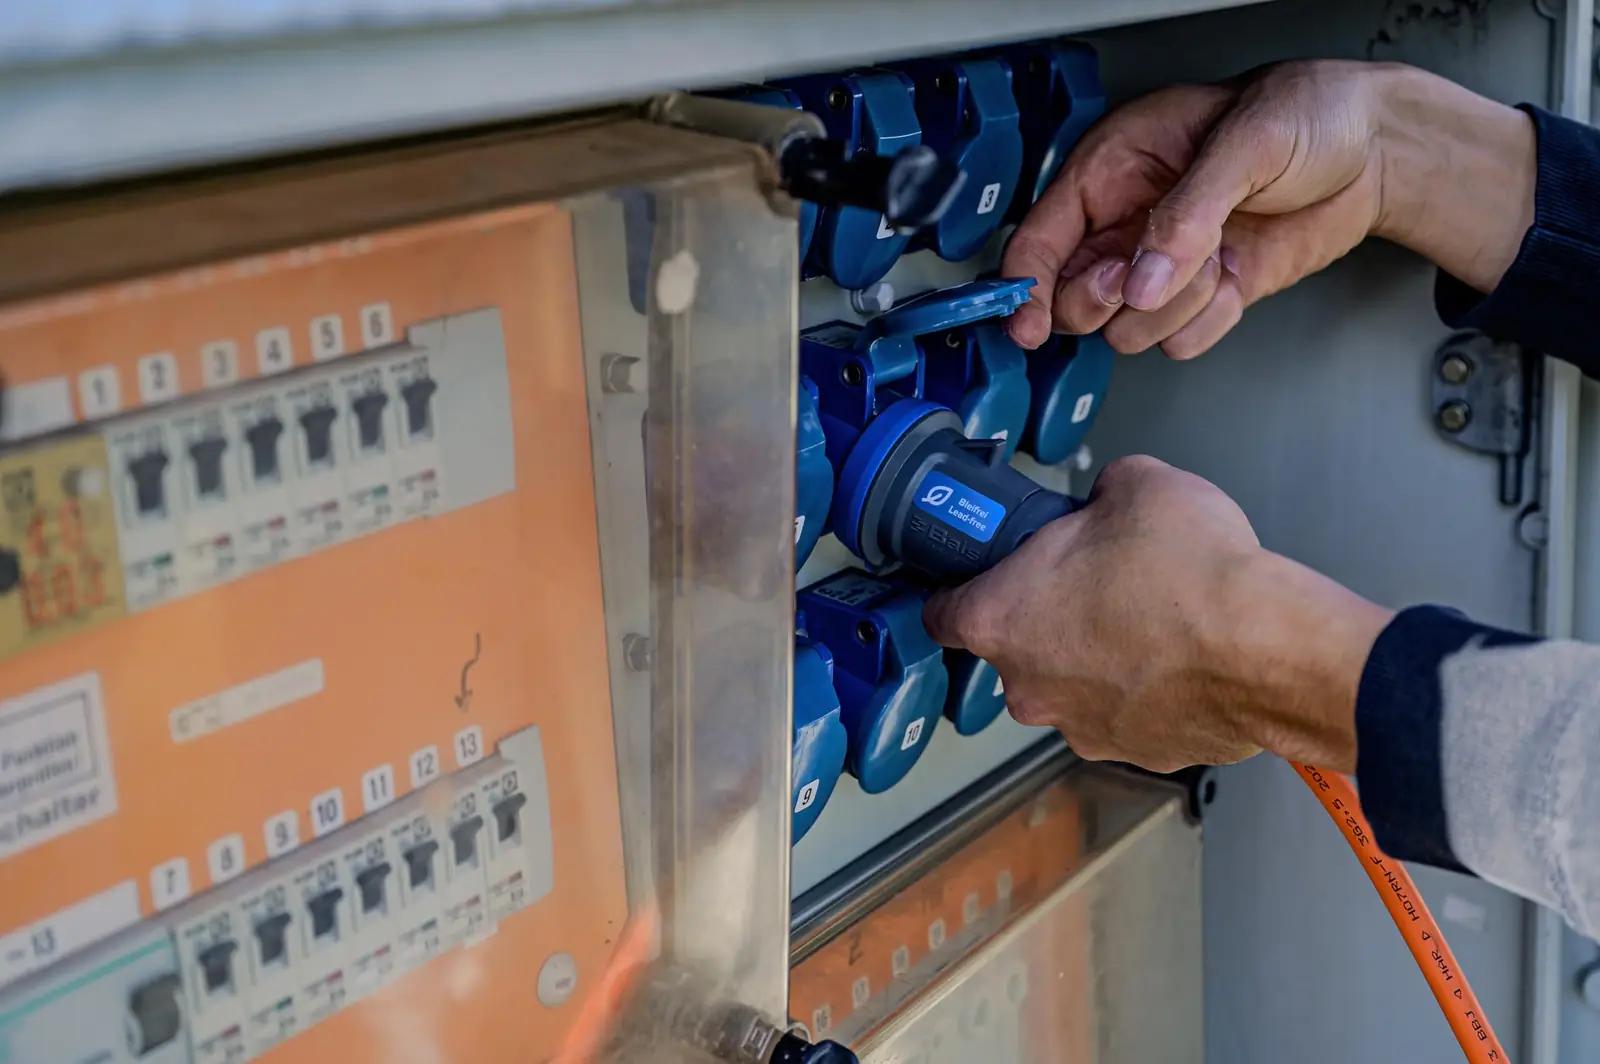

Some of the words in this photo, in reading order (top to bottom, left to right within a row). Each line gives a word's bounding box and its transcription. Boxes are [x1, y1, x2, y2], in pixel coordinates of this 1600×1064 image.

[266, 338, 282, 364] 4
[319, 320, 336, 350] 5
[368, 310, 384, 339] 6
[947, 504, 987, 533] Lead-free
[958, 497, 990, 520] Bleifrei
[906, 724, 921, 745] 10
[274, 821, 289, 848] 9
[316, 797, 339, 827] 10
[369, 772, 388, 801] 11
[416, 751, 435, 779] 12
[460, 732, 478, 760] 13
[802, 787, 813, 806] 9
[1431, 949, 1454, 982] HAR
